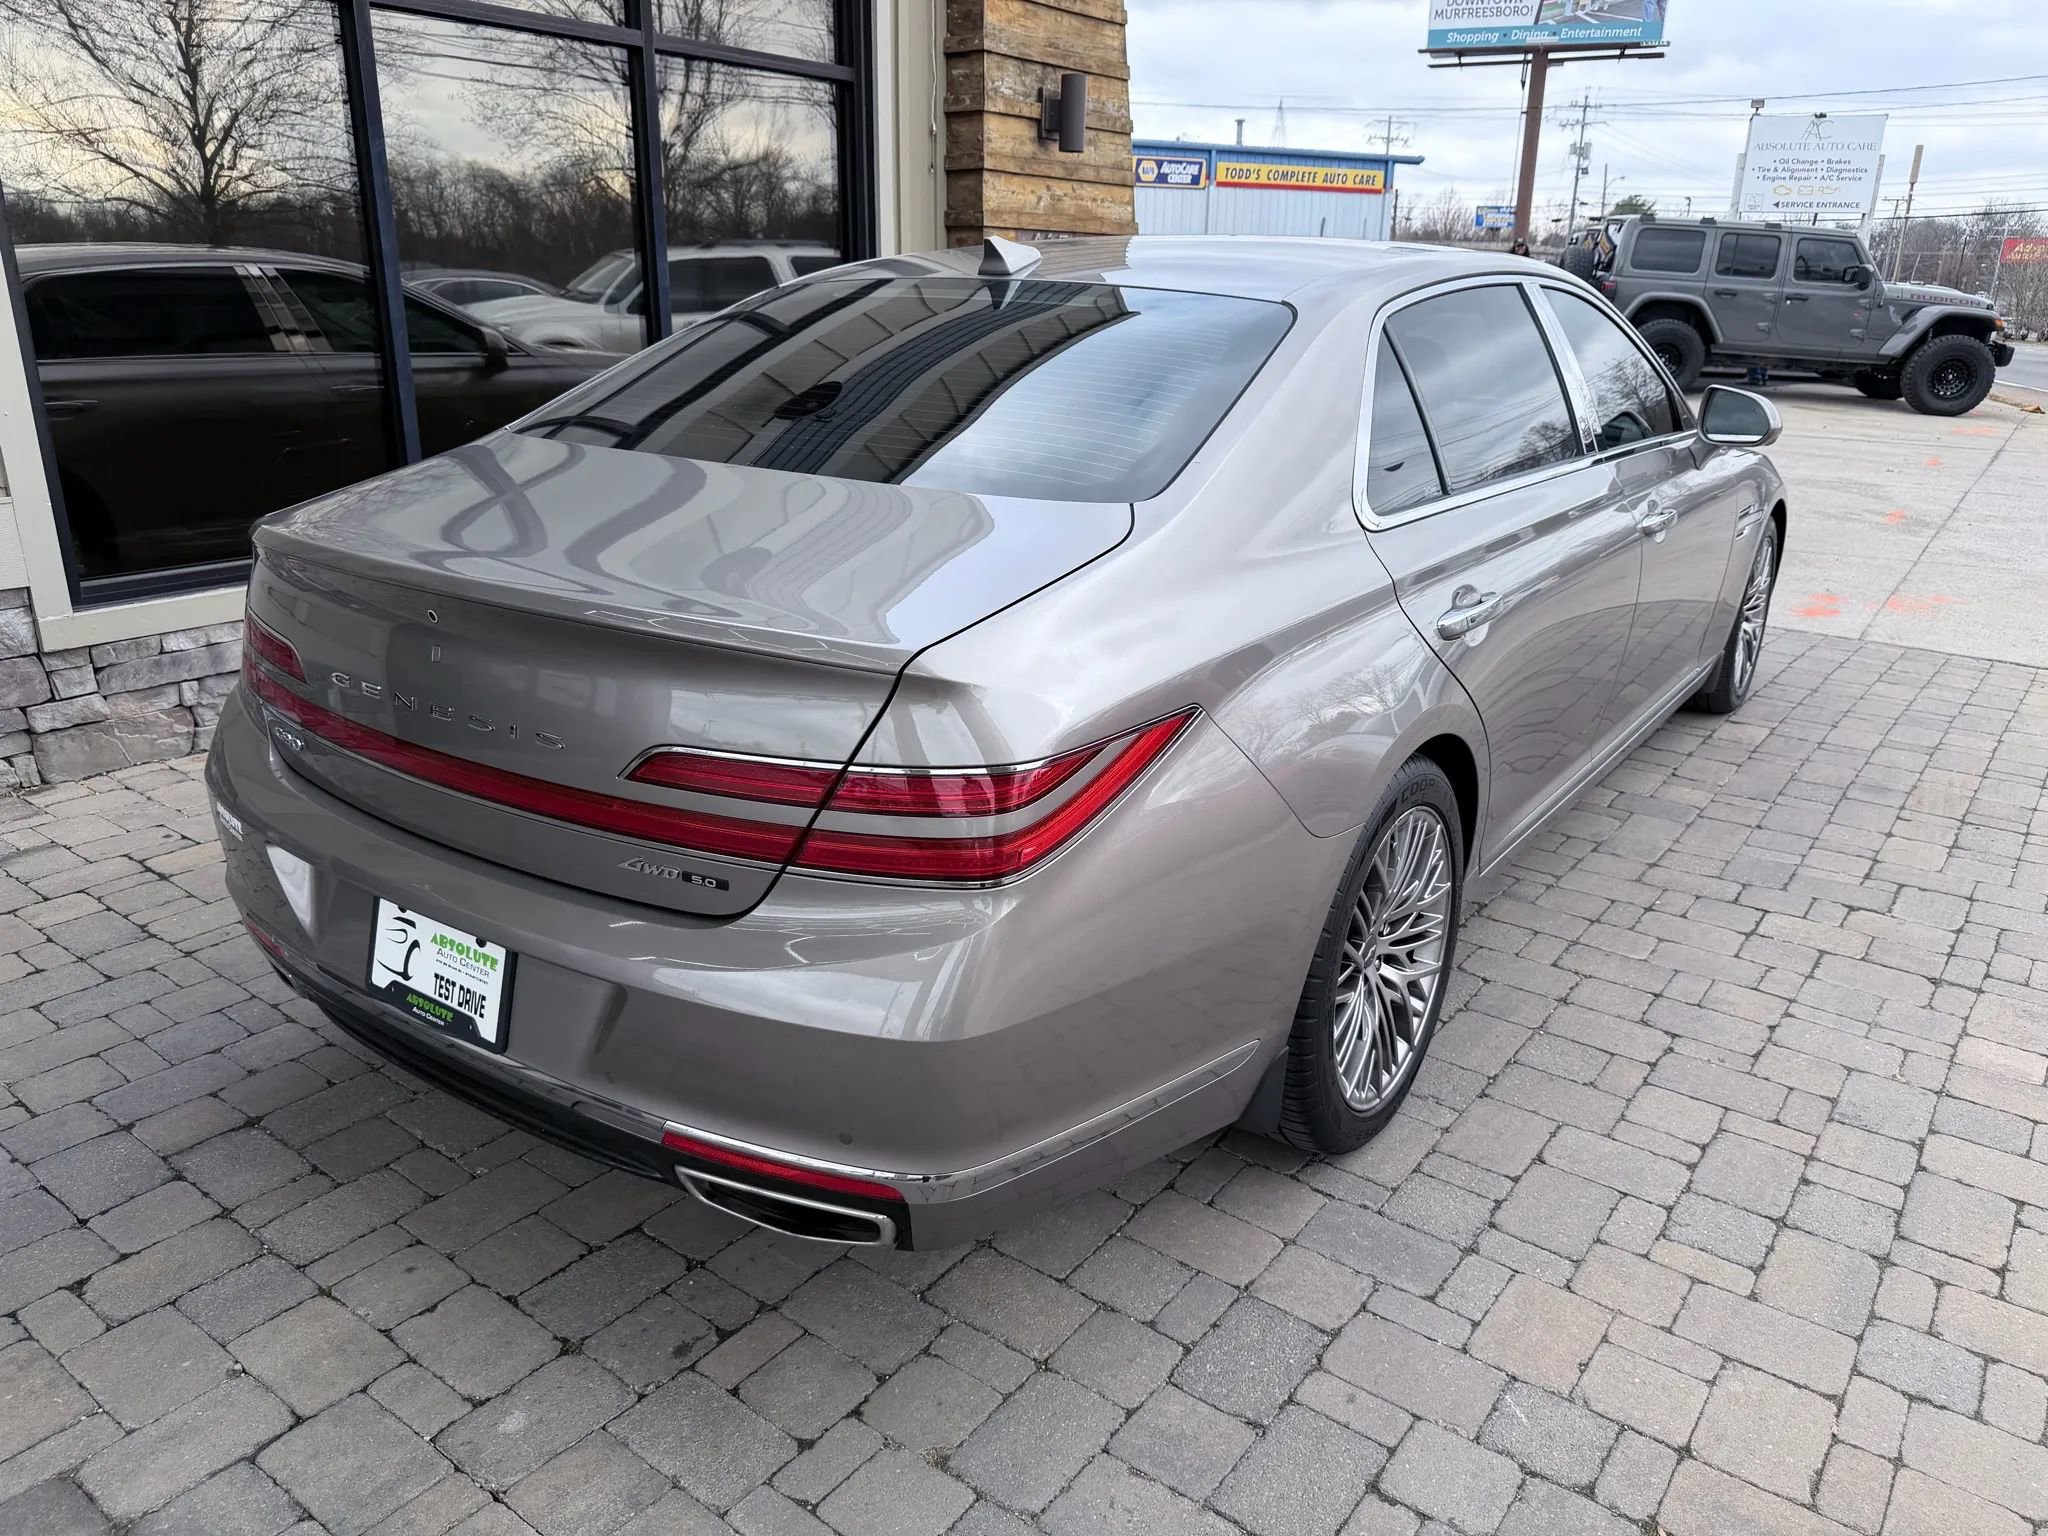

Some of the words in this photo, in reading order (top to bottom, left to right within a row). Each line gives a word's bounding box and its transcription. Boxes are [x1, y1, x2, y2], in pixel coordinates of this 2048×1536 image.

[1434, 5, 1534, 20] MURFREESBORO!
[1446, 31, 1500, 44] Shopping
[1560, 27, 1642, 38] Entertainment
[1754, 142, 1811, 151] ABSOLUTE
[1813, 142, 1844, 151] AUTO
[1847, 142, 1877, 151] CARE
[1791, 158, 1819, 167] Change
[1224, 167, 1261, 180] TODD'S
[1266, 169, 1318, 183] COMPLETE
[1322, 171, 1349, 185] AUTO
[1353, 173, 1378, 186] CARE
[1781, 166, 1818, 175] Alignment
[1826, 166, 1868, 175] Diagnostics
[1167, 173, 1193, 184] CENTER
[1762, 174, 1787, 183] Engine
[1788, 174, 1812, 182] Repair
[1836, 174, 1863, 182] Service
[1780, 200, 1814, 209] SERVICE
[1816, 200, 1861, 209] ENTRANCE
[1910, 293, 1981, 307] RUBICON
[331, 671, 566, 750] GENESIS
[691, 874, 717, 888] 5.0
[431, 931, 499, 972] ABSOLUTE
[433, 972, 457, 1004] TEST
[457, 984, 487, 1019] DRIVE
[406, 992, 455, 1022] ABSOLUTE
